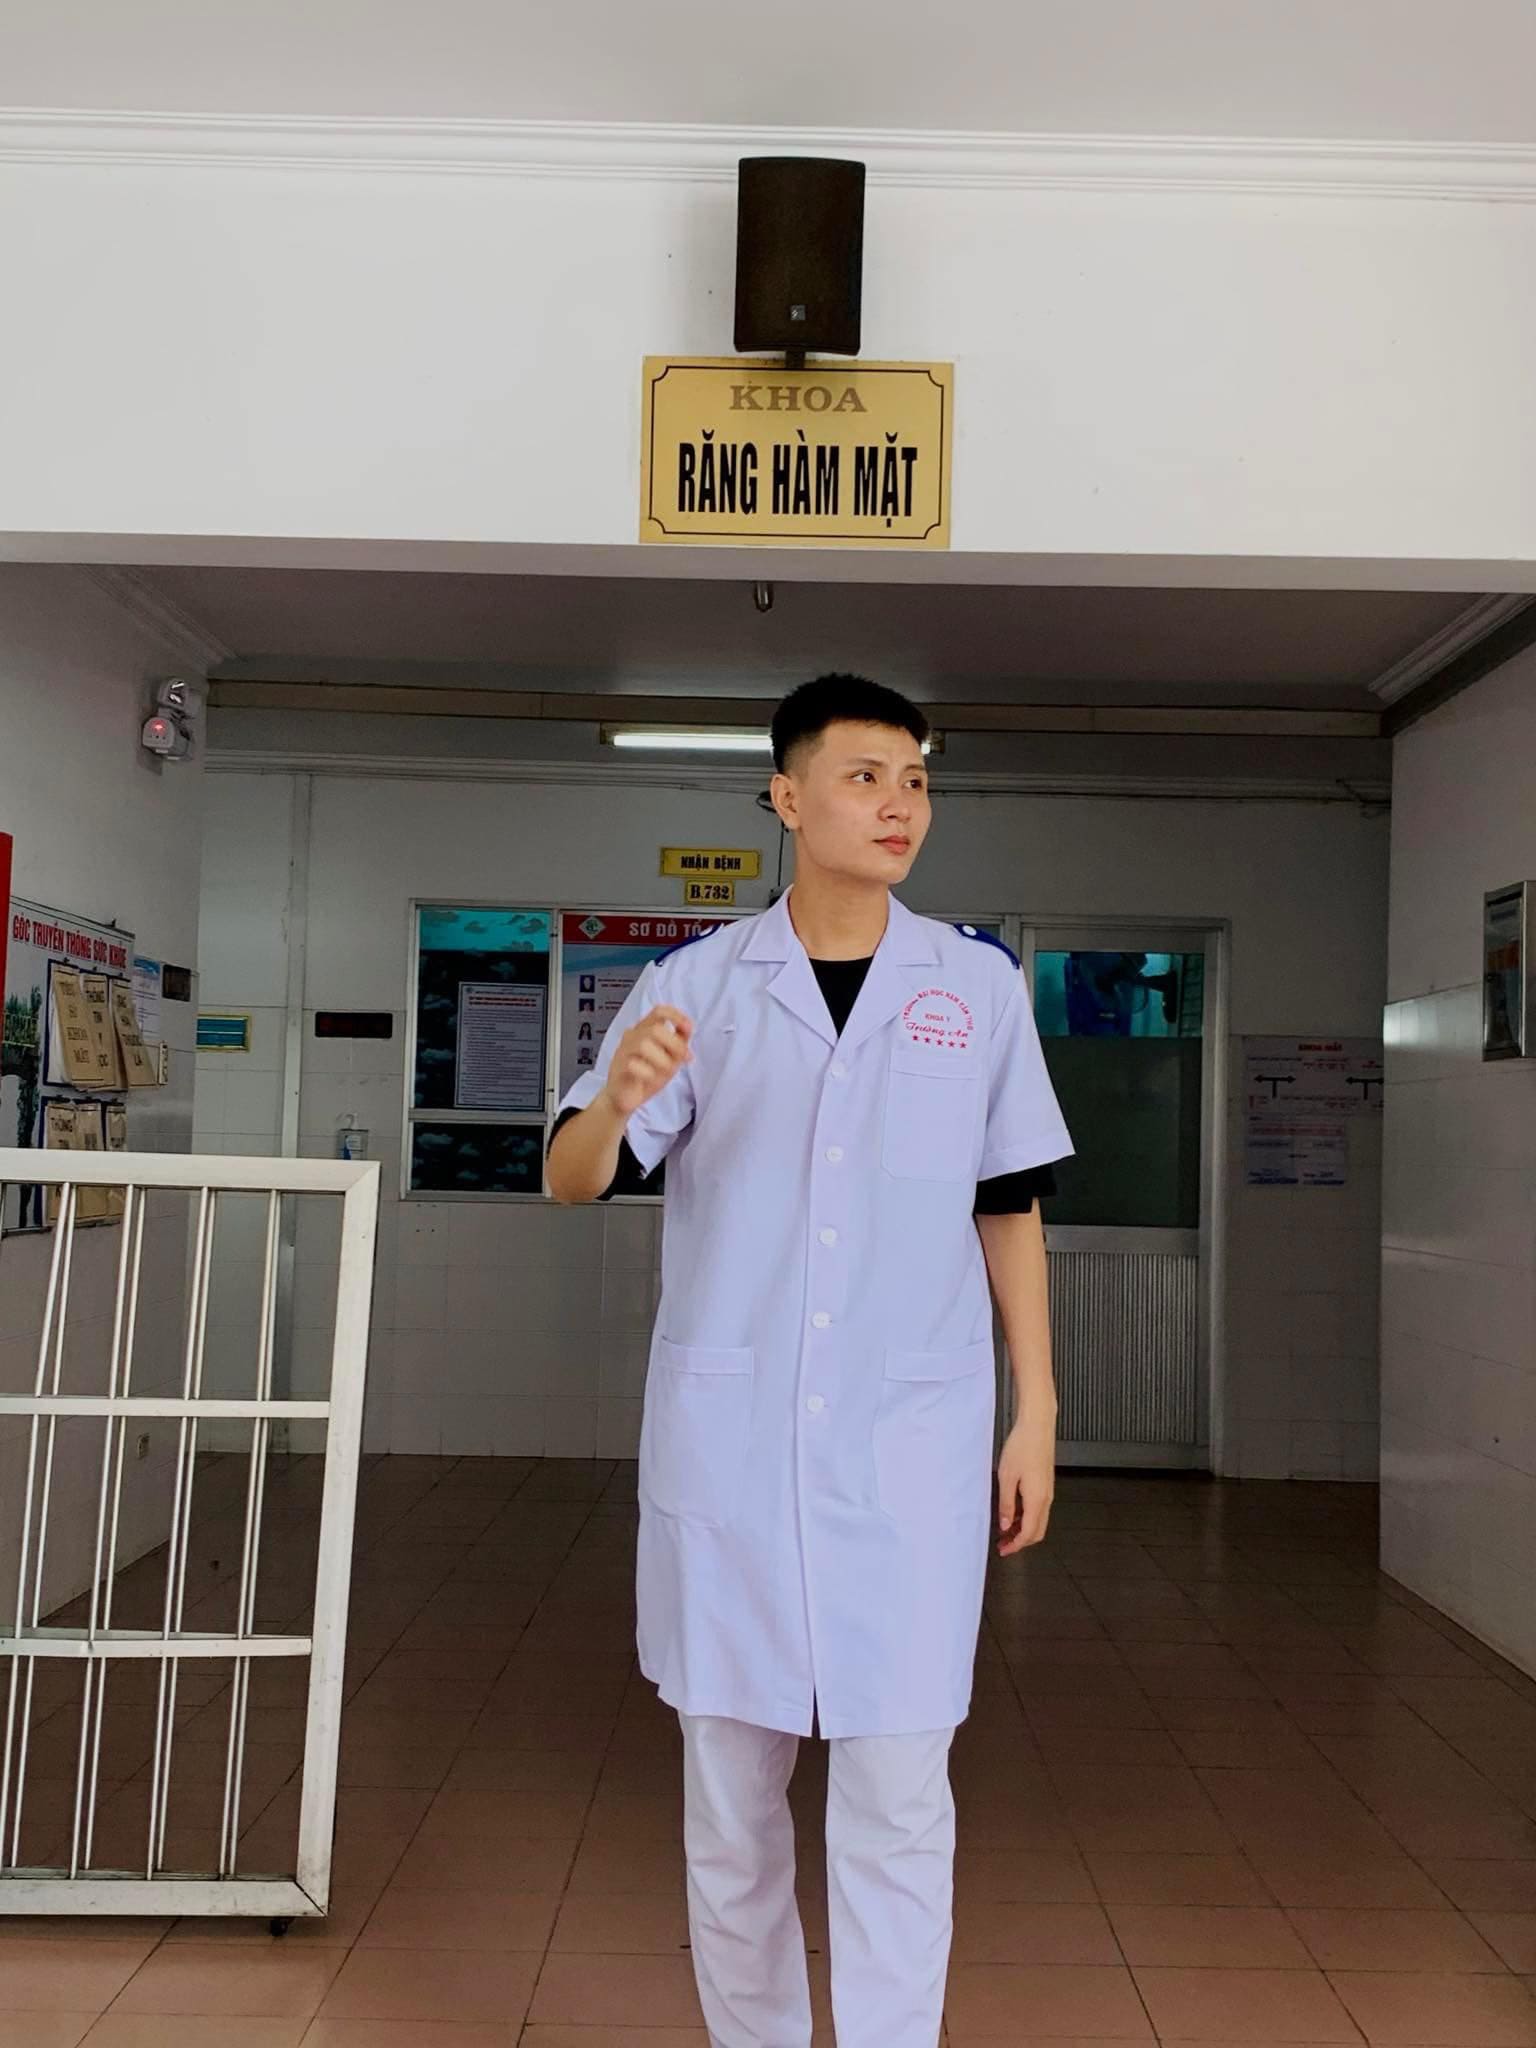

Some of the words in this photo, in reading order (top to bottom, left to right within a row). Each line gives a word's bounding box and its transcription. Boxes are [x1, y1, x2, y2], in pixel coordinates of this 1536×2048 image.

[729, 385, 867, 412] KHOA
[678, 429, 758, 515] RĂNG
[772, 429, 840, 516] HÀM
[854, 432, 918, 528] MẶT
[681, 854, 709, 871] NHẬN
[714, 855, 742, 872] BỆNH
[690, 885, 730, 900] B.732
[13, 912, 31, 942] GÓC
[629, 922, 651, 937] SƠ
[656, 919, 678, 937] ĐỒ
